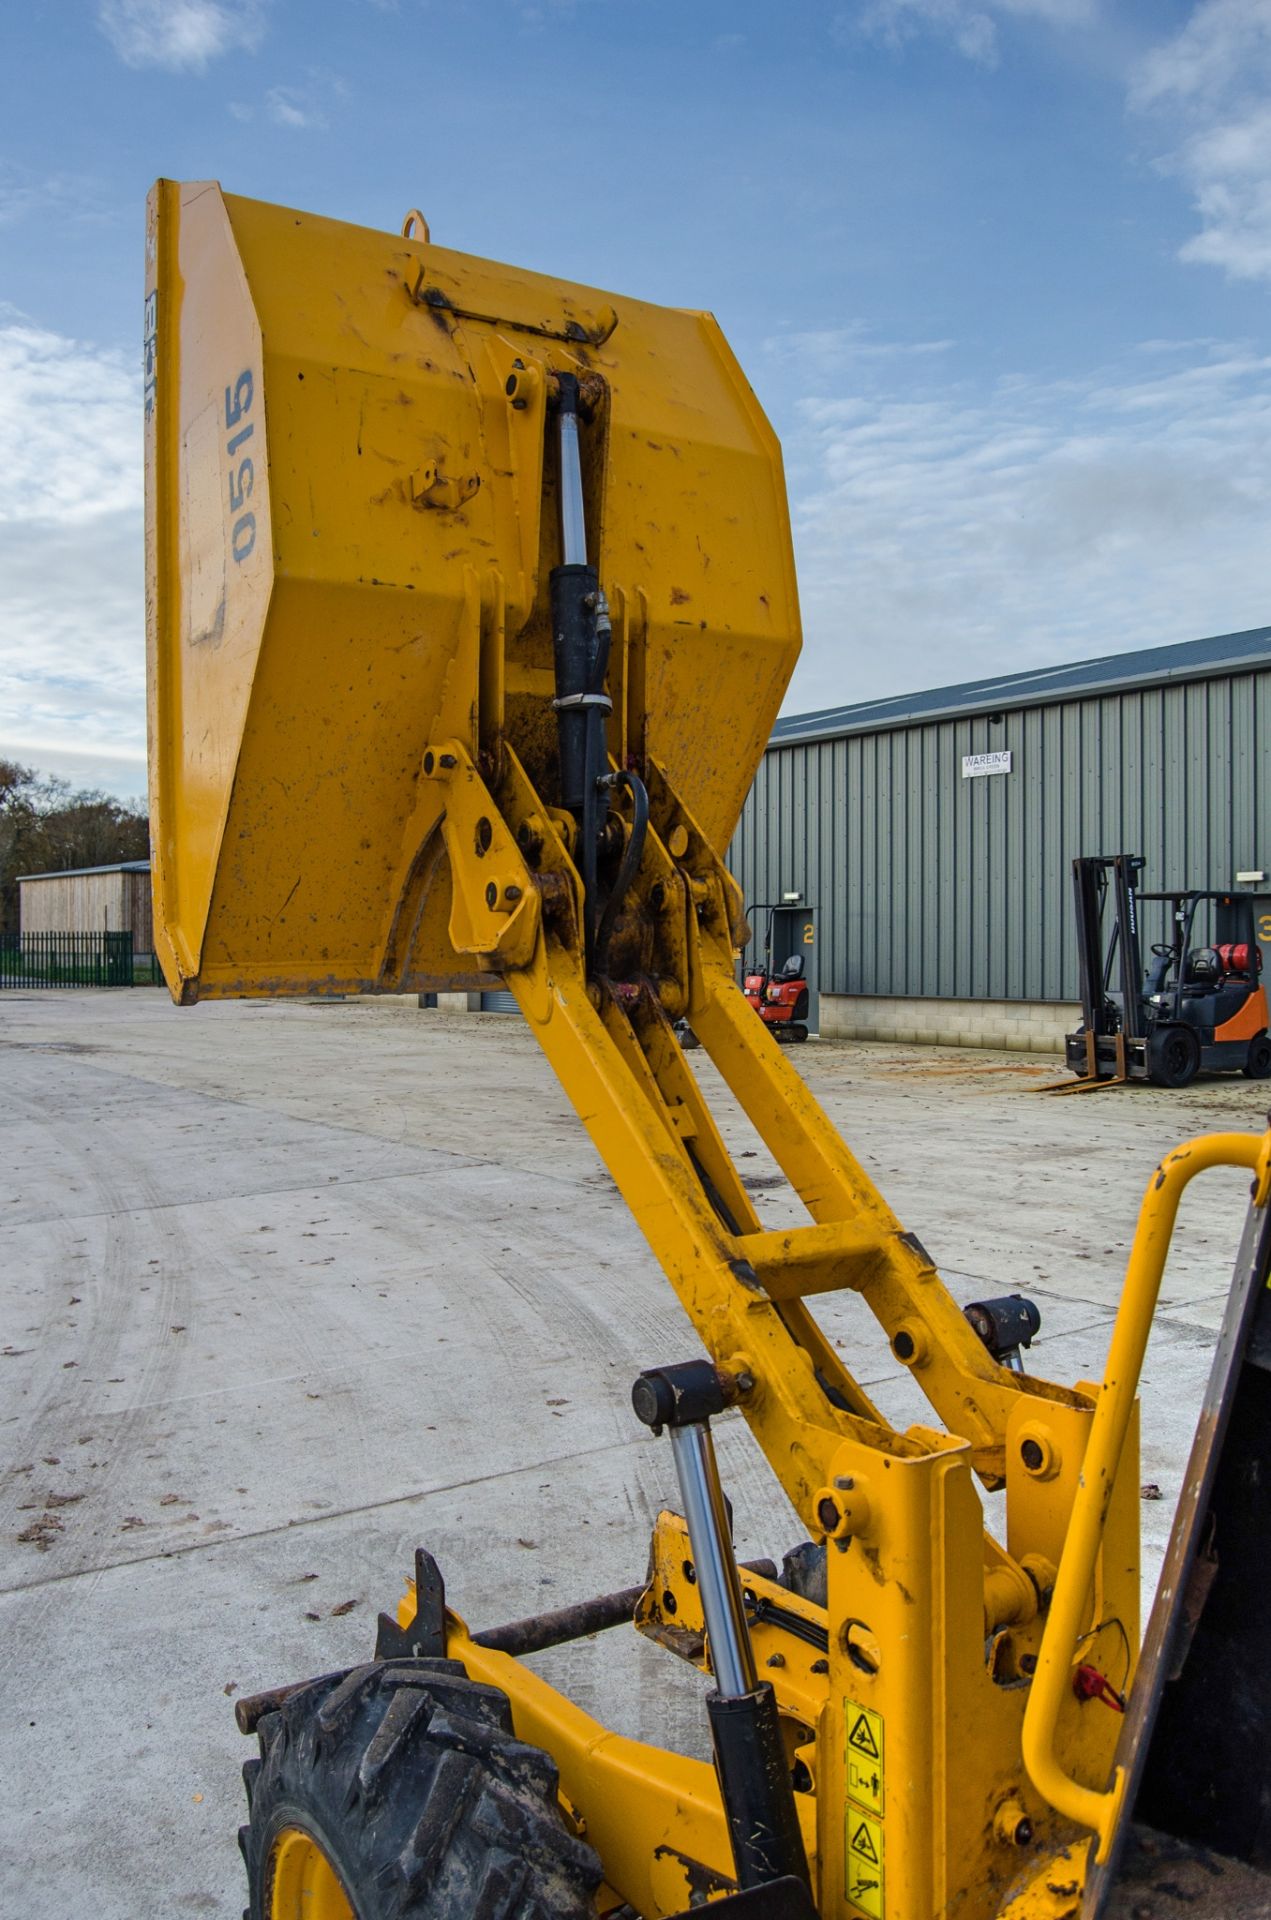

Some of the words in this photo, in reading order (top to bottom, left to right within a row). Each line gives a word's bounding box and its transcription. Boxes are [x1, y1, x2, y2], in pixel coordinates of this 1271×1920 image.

[225, 369, 256, 562] 0515
[964, 752, 1009, 767] WAREING
[803, 924, 815, 944] 2
[1258, 915, 1271, 942] 3
